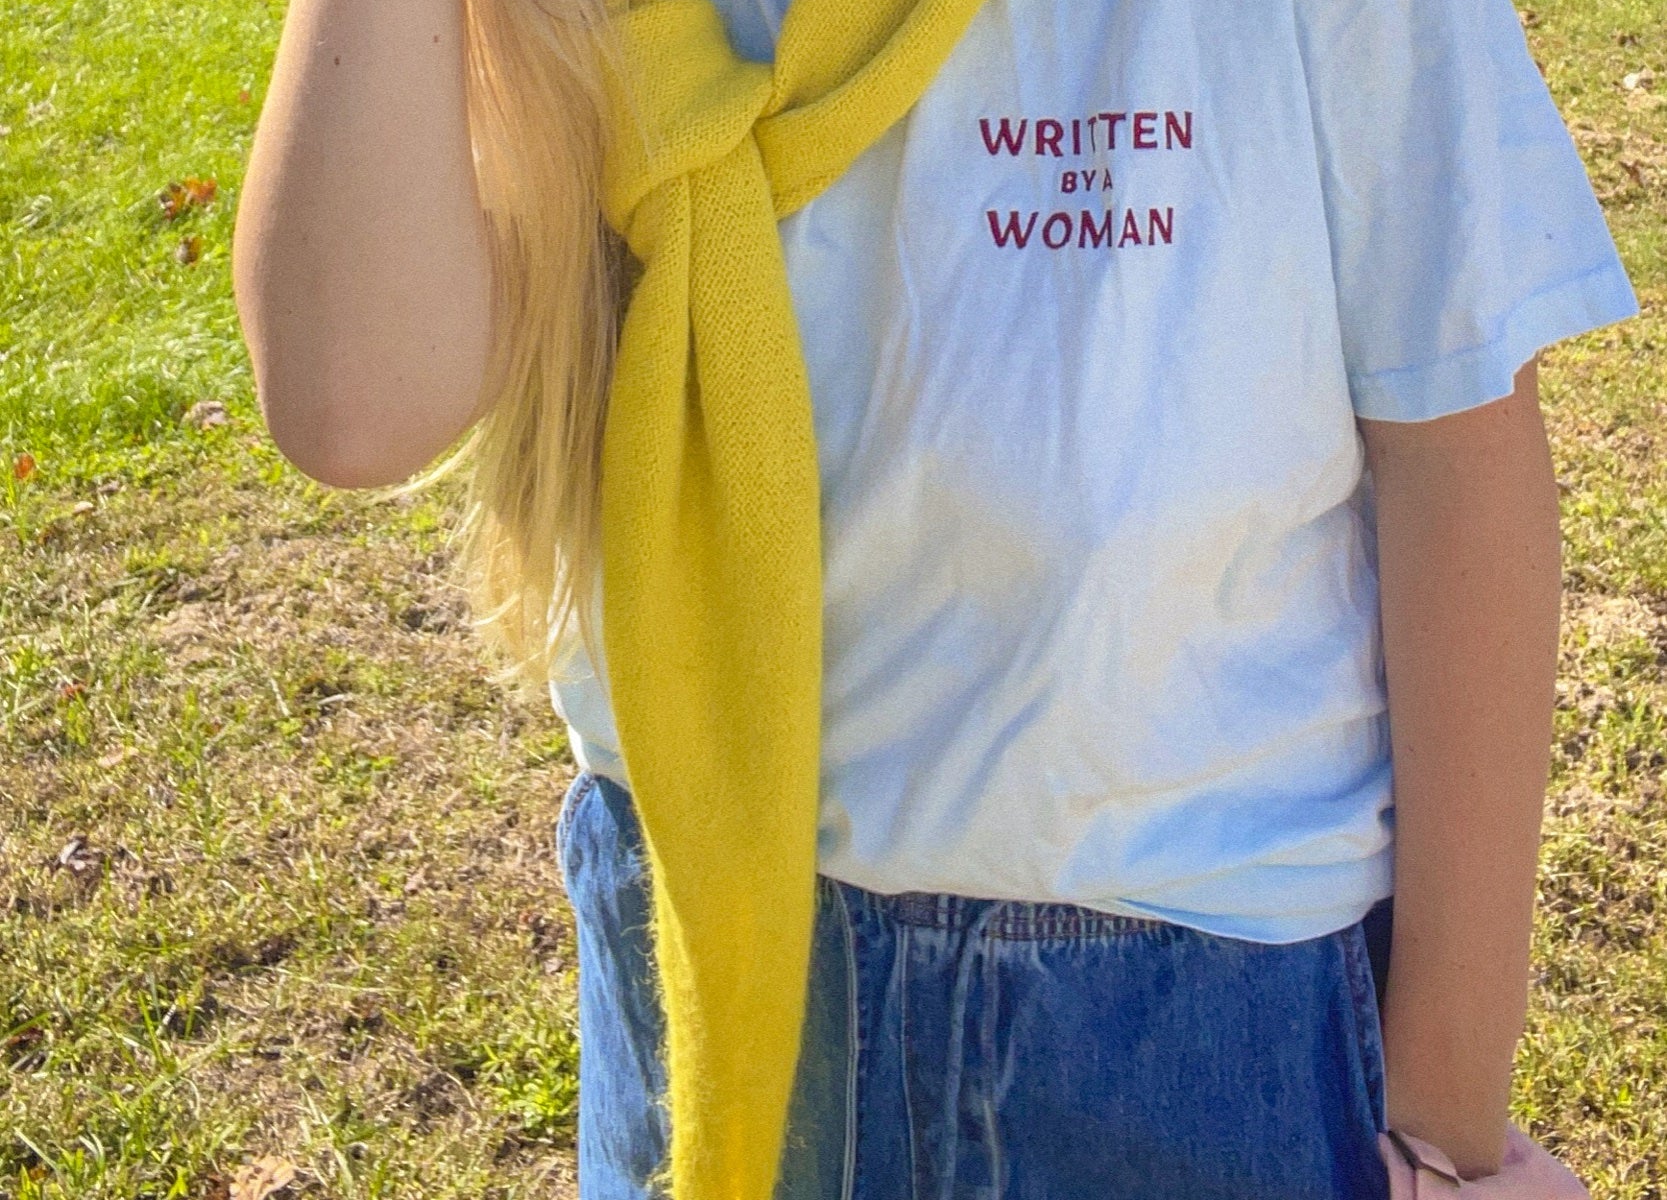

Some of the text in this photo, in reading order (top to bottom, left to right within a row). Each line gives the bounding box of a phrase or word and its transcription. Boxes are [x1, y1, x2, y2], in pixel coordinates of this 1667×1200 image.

[1061, 168, 1113, 194] BY A
[987, 207, 1173, 250] WOMAN
